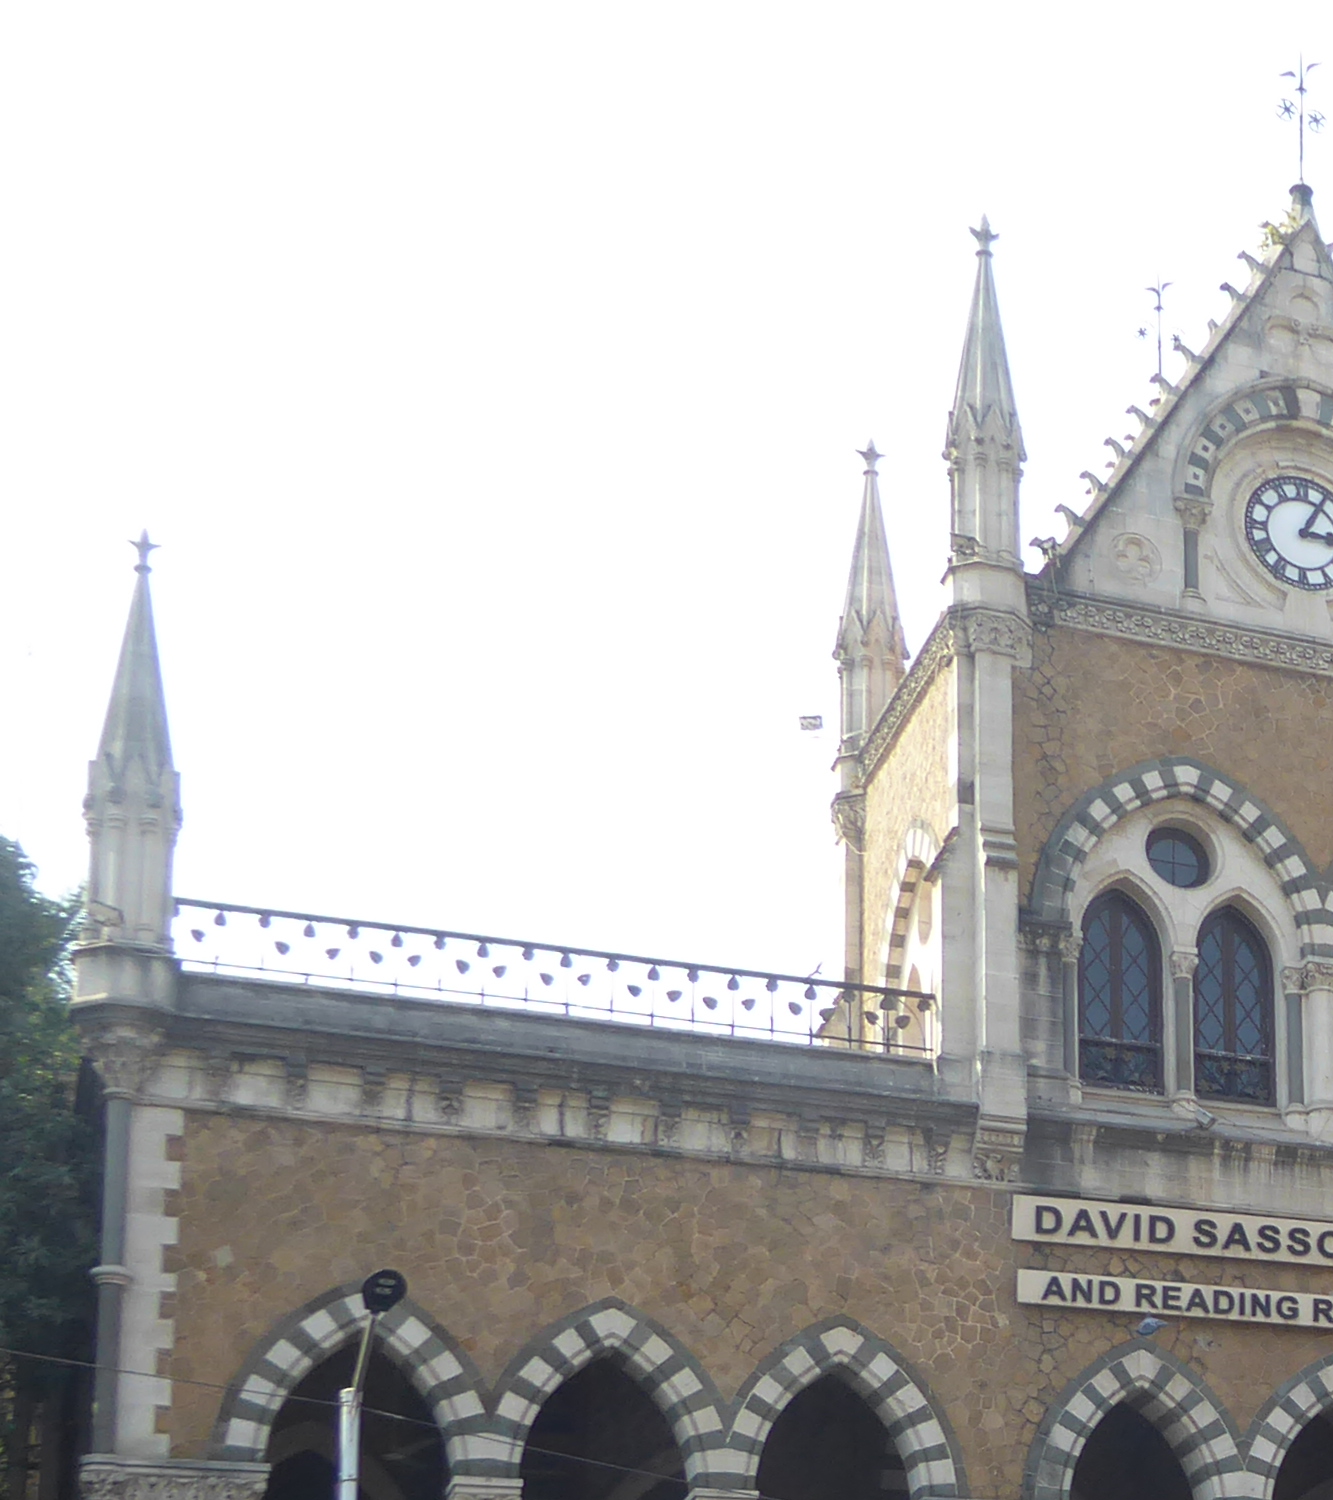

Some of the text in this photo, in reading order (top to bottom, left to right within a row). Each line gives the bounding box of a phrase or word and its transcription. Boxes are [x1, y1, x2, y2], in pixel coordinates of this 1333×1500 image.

[1034, 1205, 1176, 1244] DAVID
[1041, 1276, 1122, 1305] AND
[1136, 1283, 1299, 1320] READING
